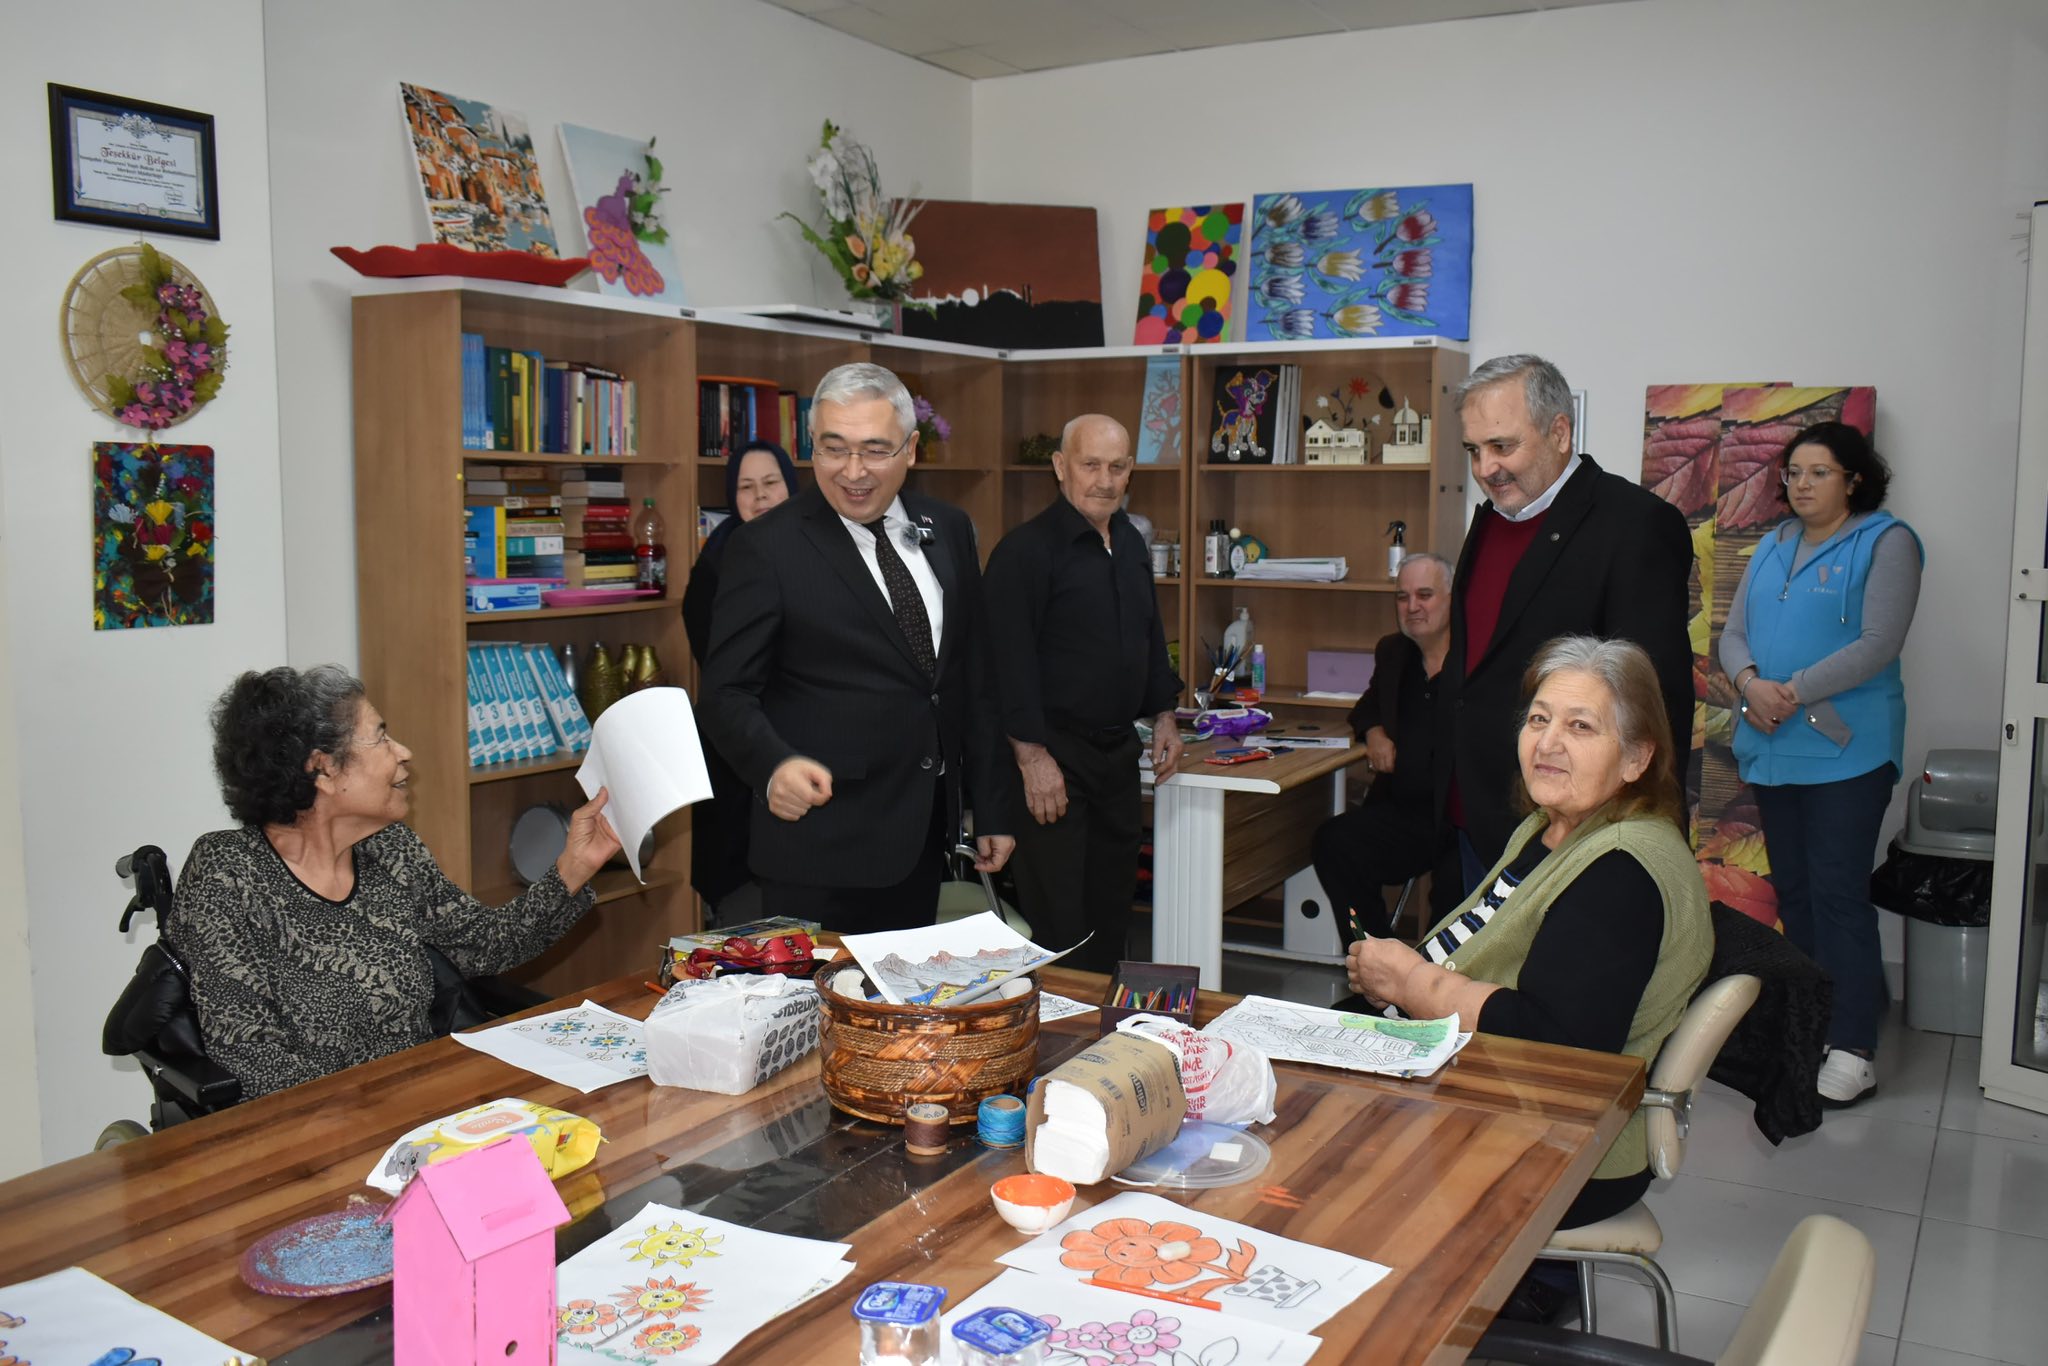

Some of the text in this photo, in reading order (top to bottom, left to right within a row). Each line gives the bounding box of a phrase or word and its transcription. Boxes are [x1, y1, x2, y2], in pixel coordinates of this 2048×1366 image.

[490, 704, 499, 720] 3
[506, 703, 514, 717] 4
[519, 702, 528, 716] 5
[533, 700, 541, 715] 6
[569, 698, 578, 712] 8
[476, 705, 485, 721] 2
